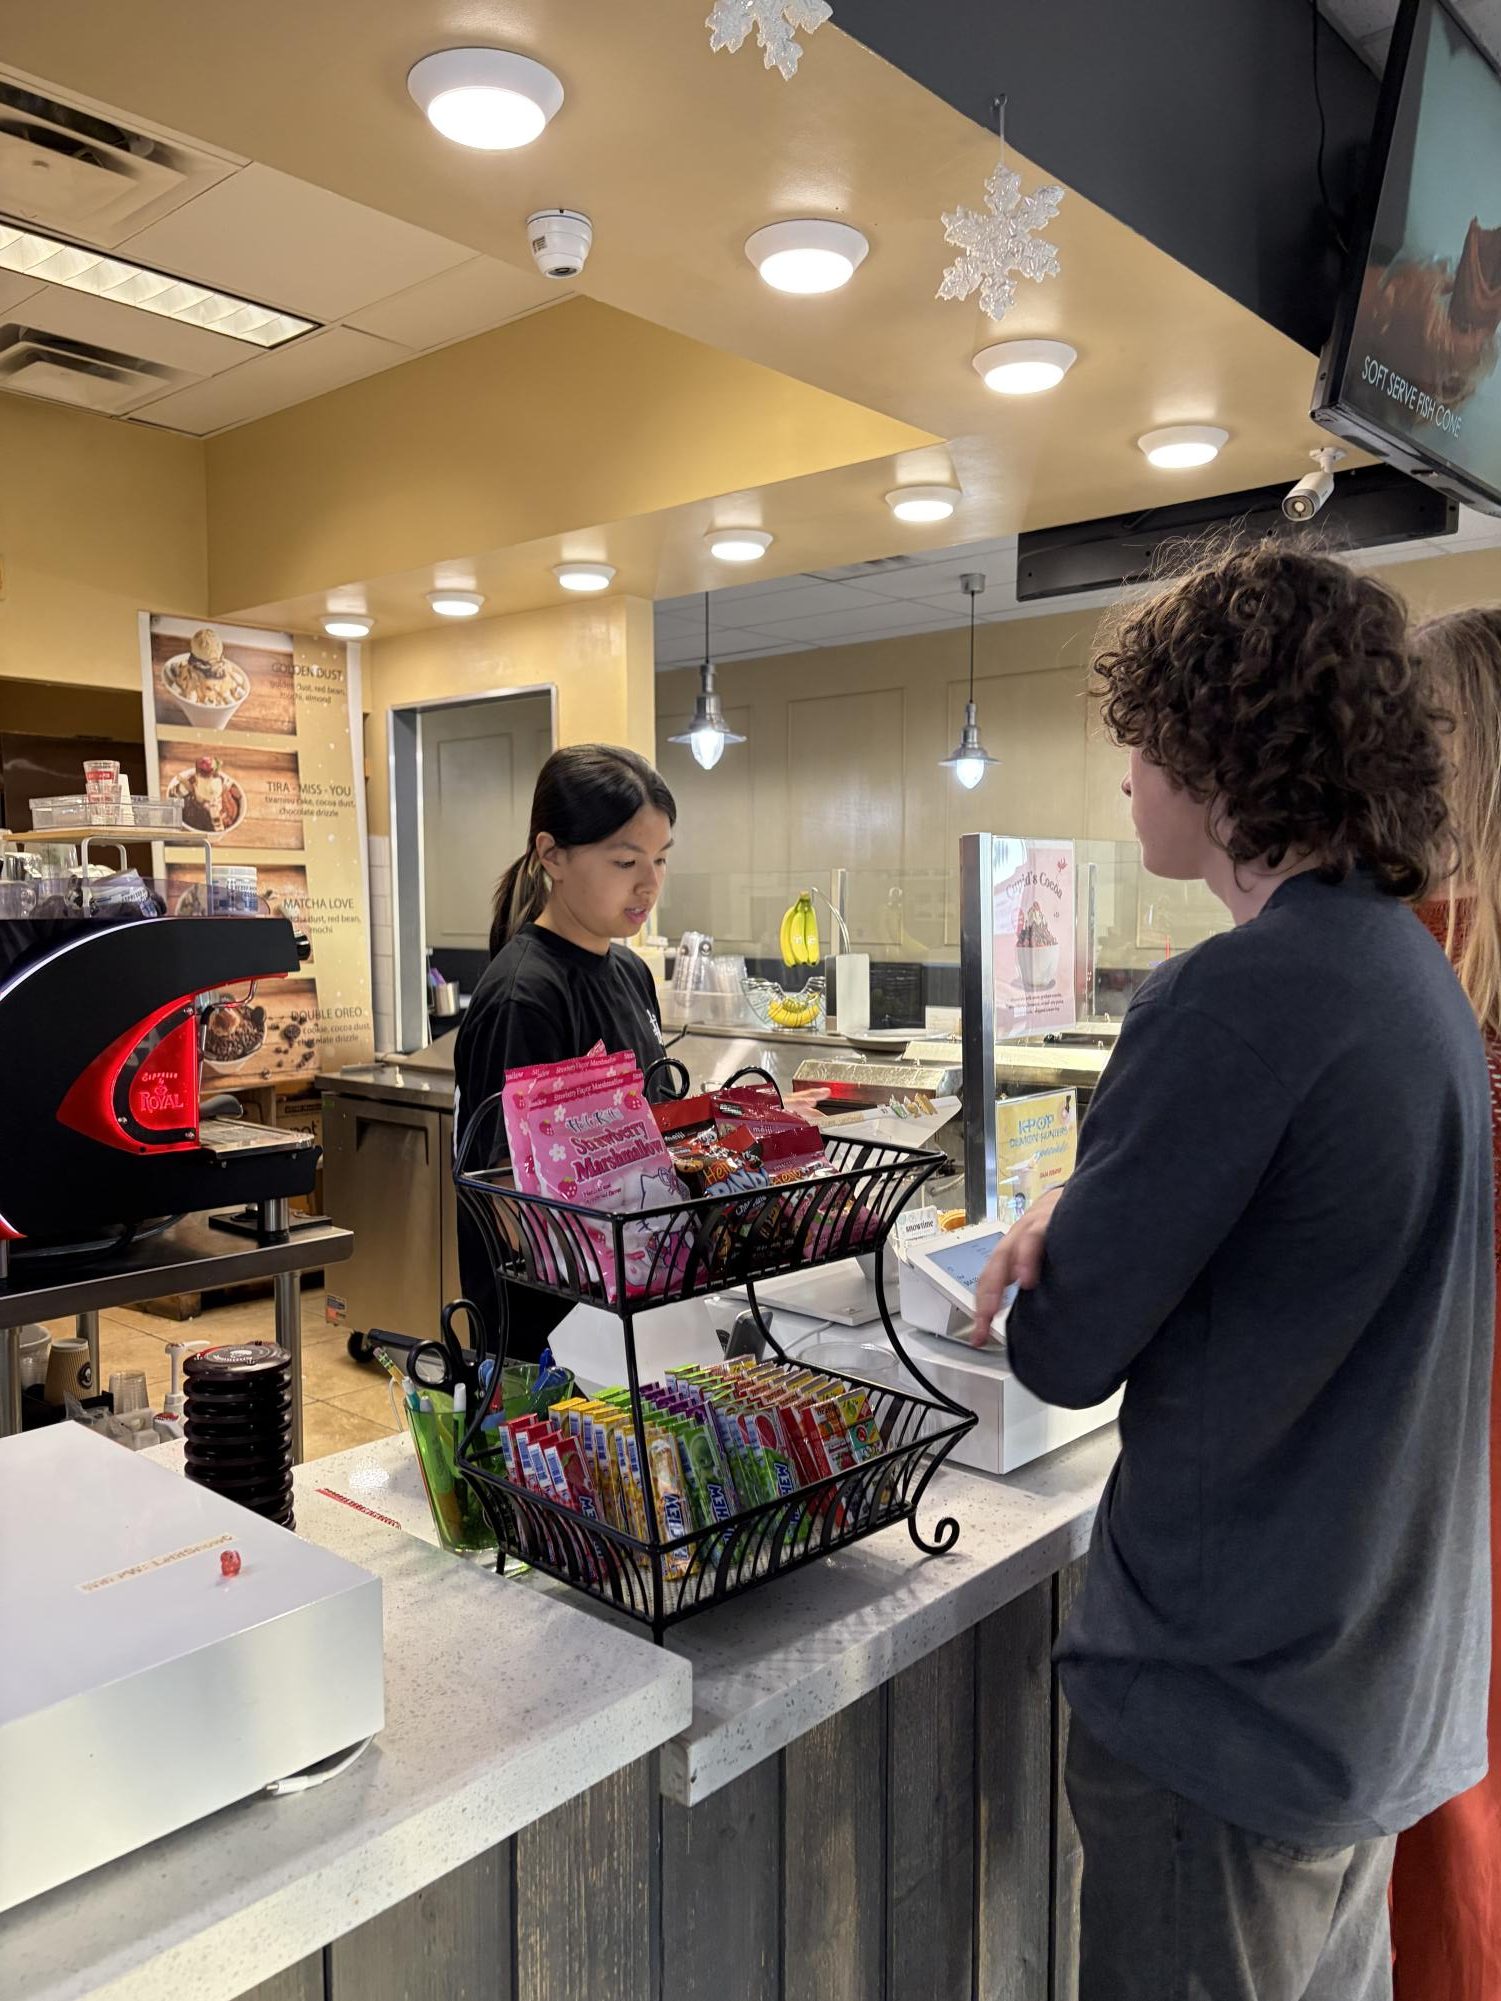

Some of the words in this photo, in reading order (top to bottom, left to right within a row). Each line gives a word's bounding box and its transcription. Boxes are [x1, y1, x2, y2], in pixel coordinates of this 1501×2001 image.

[1362, 355, 1389, 391] SOFT
[1387, 371, 1418, 410] SERVE
[1416, 391, 1436, 421] FISH
[1435, 405, 1462, 438] CONE
[272, 662, 313, 677] GOLDEN
[317, 667, 343, 680] DUST
[266, 781, 290, 793] TIRA
[298, 784, 322, 796] MISS
[329, 784, 352, 797] YOU
[1006, 871, 1038, 898] Cupid's
[1040, 872, 1063, 899] Cocoa
[283, 898, 327, 910] MATCHA
[329, 898, 354, 909] LOVE
[291, 1008, 333, 1021] DOUBLE
[334, 1006, 363, 1019] OREO
[1018, 1114, 1055, 1135] KPOP
[570, 1120, 649, 1155] Strawberry
[571, 1138, 664, 1183] Marshmallow
